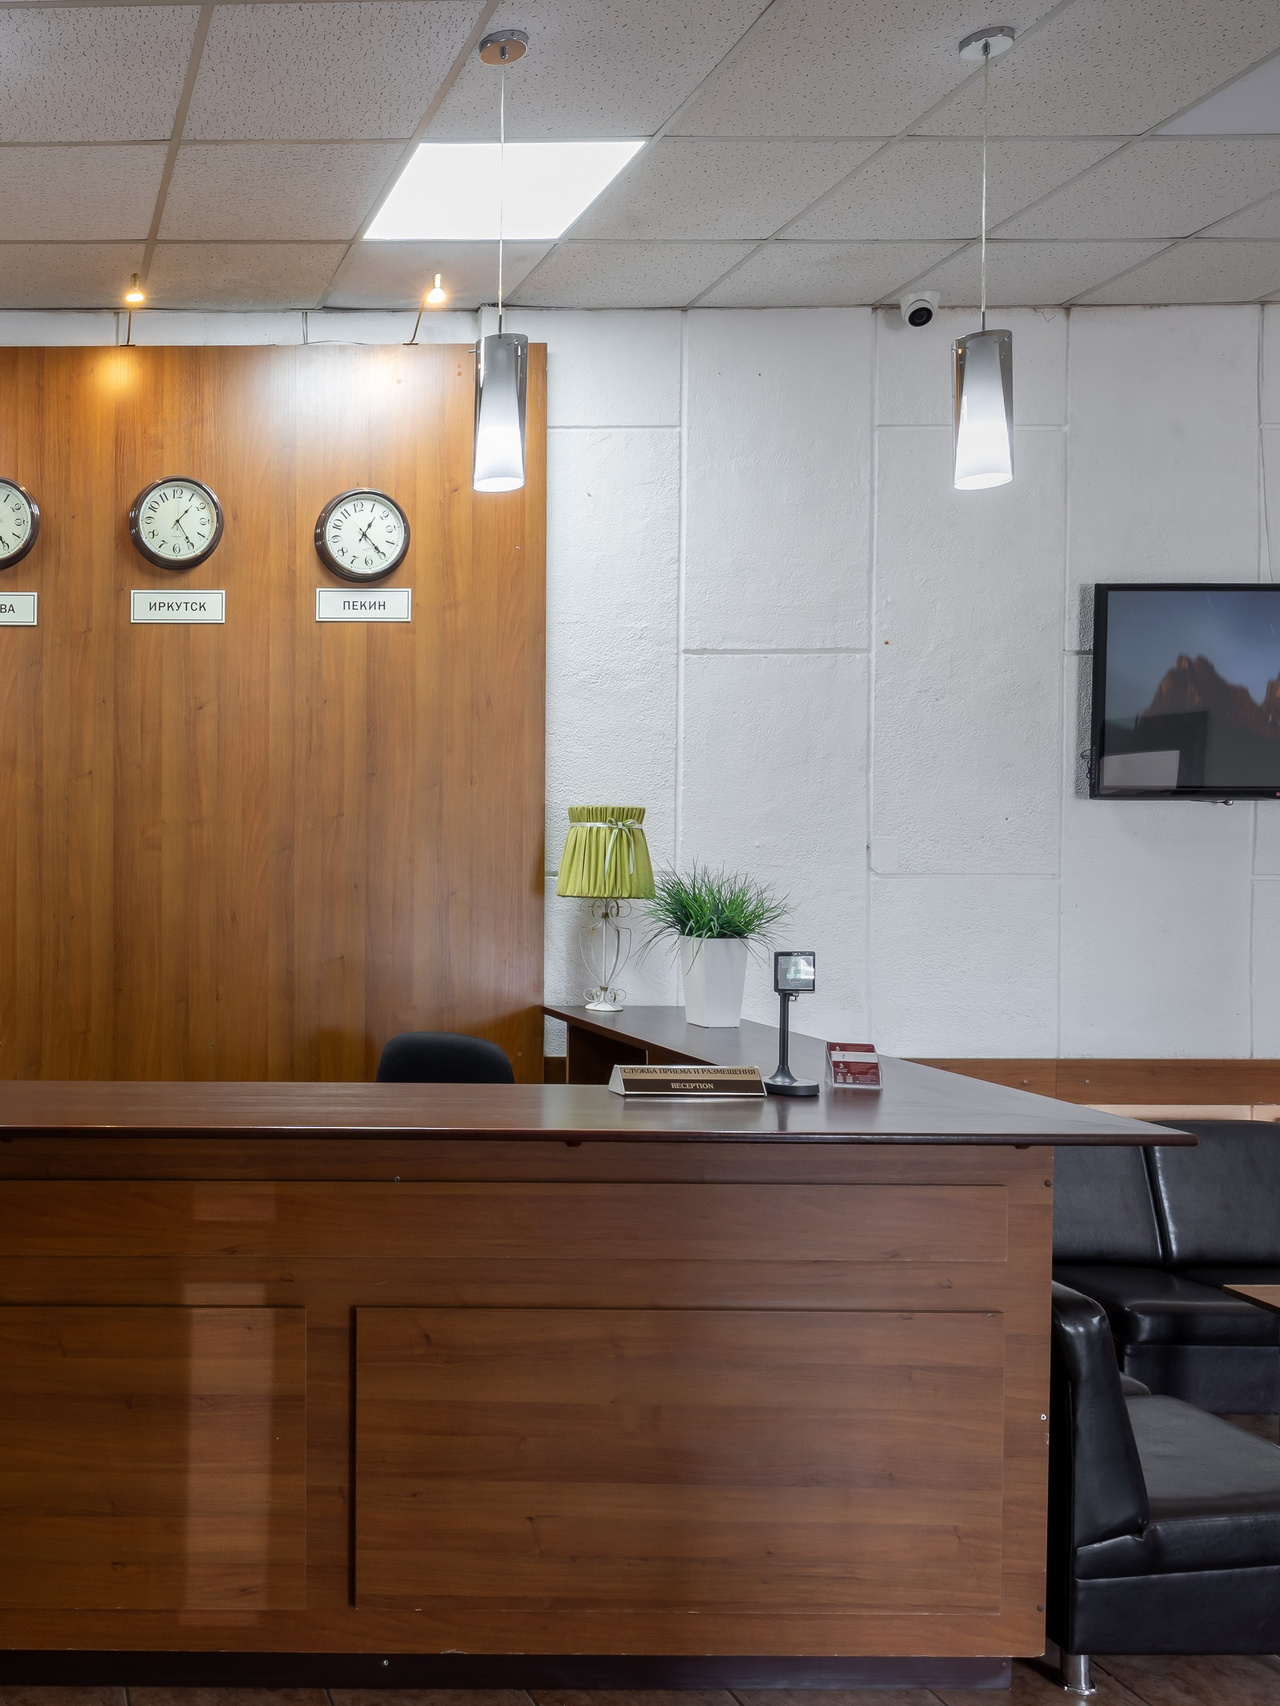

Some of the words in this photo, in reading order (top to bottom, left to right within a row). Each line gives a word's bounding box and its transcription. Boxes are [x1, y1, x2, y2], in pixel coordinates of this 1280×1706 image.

[159, 492, 169, 503] 11
[173, 488, 183, 498] 12
[189, 493, 194, 502] 1
[4, 494, 10, 503] 1
[11, 503, 21, 512] 2
[148, 501, 160, 513] 10
[196, 503, 206, 511] 2
[353, 502, 364, 513] 12
[371, 504, 375, 512] 1
[341, 509, 351, 519] 11
[379, 510, 389, 520] 2
[332, 519, 343, 530] 10
[148, 530, 158, 539] 8
[331, 535, 342, 543] 9
[158, 540, 168, 548] 7
[173, 543, 180, 554] 6
[337, 547, 348, 556] 8
[350, 556, 359, 564] 7
[365, 556, 373, 566] 6
[149, 601, 207, 612] ИРКУТСК
[343, 600, 386, 611] ПЕКИН
